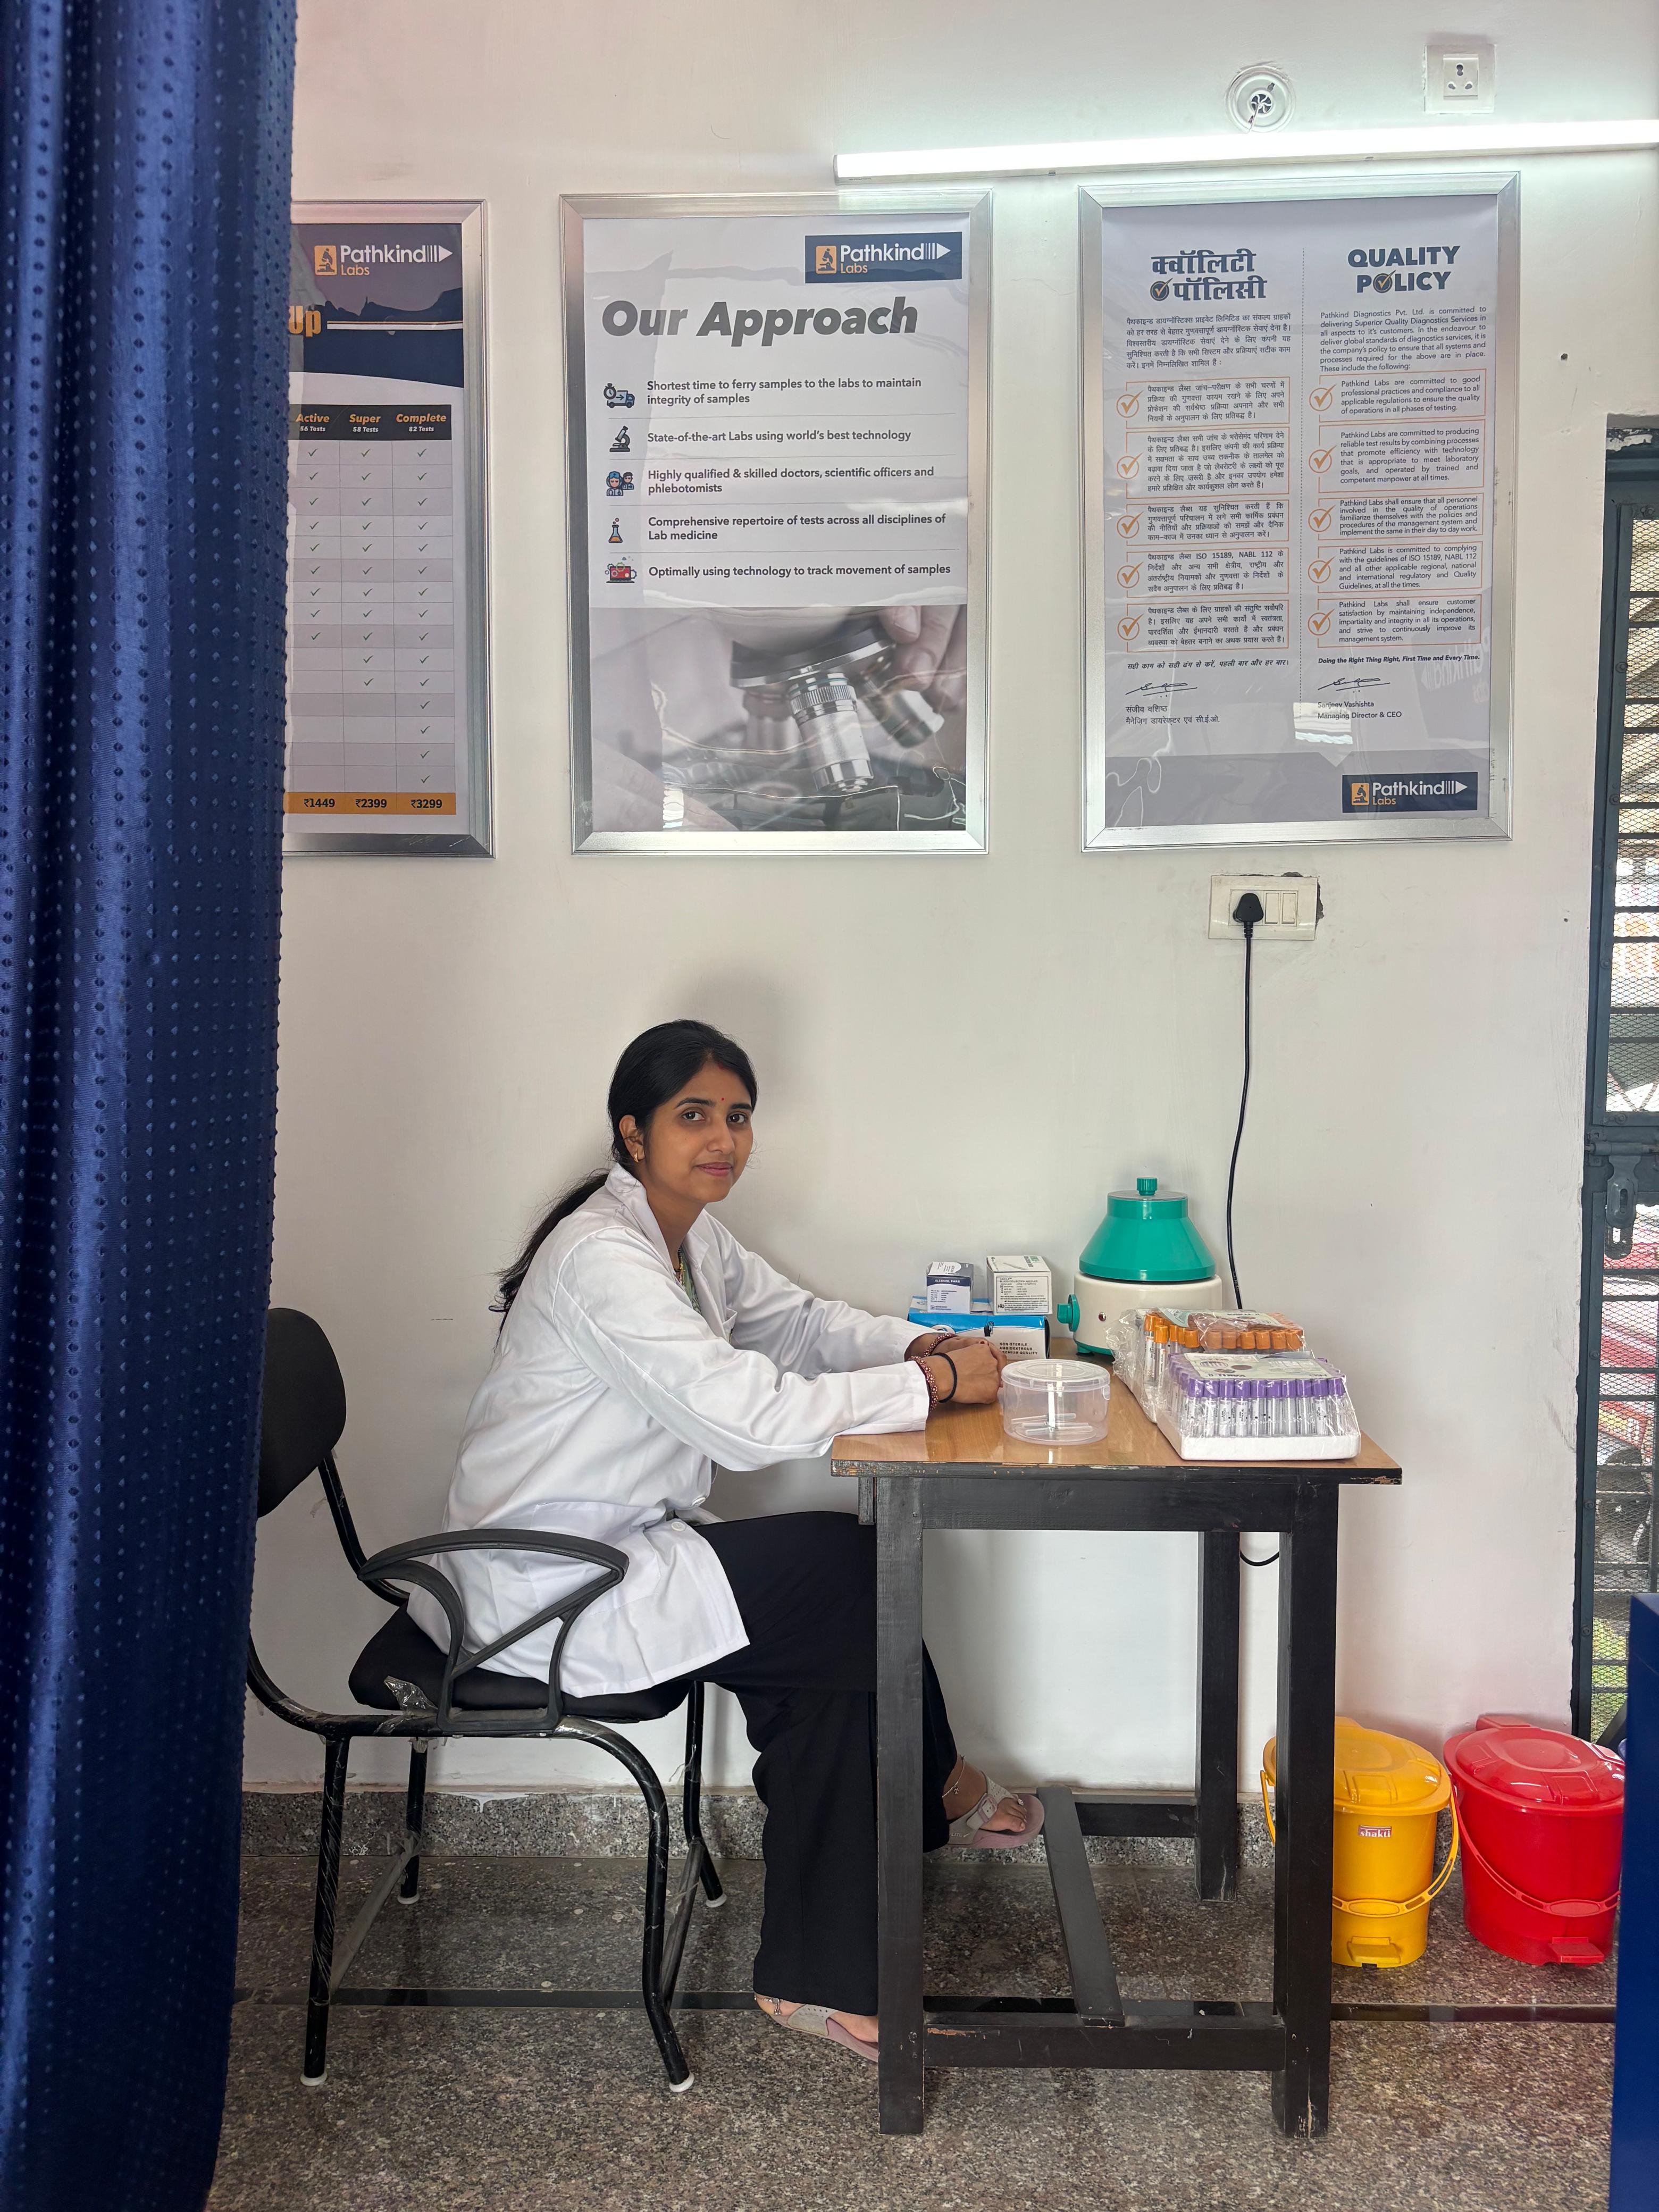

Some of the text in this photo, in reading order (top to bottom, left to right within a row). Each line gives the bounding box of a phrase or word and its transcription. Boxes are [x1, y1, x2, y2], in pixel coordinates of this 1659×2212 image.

[340, 244, 426, 263] Pathkind
[840, 242, 924, 262] Pathkind
[1347, 245, 1461, 268] QUALITY
[1151, 248, 1257, 275] क्वॉलिटी
[340, 264, 370, 275] Labs
[840, 263, 868, 273] Labs
[1172, 275, 1268, 301] पॉलिसी
[1353, 310, 1392, 319] Diagnostics
[1438, 306, 1475, 314] committed
[602, 296, 918, 347] Our Approach
[1355, 319, 1383, 328] Superior
[1385, 318, 1409, 326] Quality
[1410, 316, 1449, 326] Diagnostics
[1344, 337, 1364, 346] global
[1407, 334, 1444, 343] diagnostics
[1333, 346, 1367, 355] company's
[1368, 345, 1388, 354] policy
[1356, 354, 1384, 363] required
[1465, 350, 1485, 359] place.
[647, 377, 921, 391] Shortest time to ferry samples to the labs to maintain
[647, 392, 750, 407] integrity of samples
[296, 413, 330, 423] Active
[349, 414, 381, 425] Super
[396, 413, 447, 425] Complete
[647, 429, 911, 443] State-of-the-art Labs using world's best technology
[648, 466, 934, 482] Highly qualified & skilled doctors, scientific officers and
[648, 483, 722, 496] phlebotomists
[648, 516, 730, 529] Comprehensive
[732, 516, 784, 528] repertoire
[786, 515, 798, 525] of
[800, 516, 824, 525] tests
[862, 514, 874, 524] all
[877, 514, 932, 526] disciplines
[935, 513, 946, 523] of
[649, 530, 718, 540] Lab medicine
[649, 563, 951, 579] Optimally using technology to track movement of samples
[1125, 703, 1168, 713] संजीव वशिष्ठ
[1183, 715, 1193, 724] एवं
[1318, 711, 1350, 720] Managing
[1372, 781, 1445, 796] Pathkind
[304, 798, 336, 808] ₹1449
[355, 798, 387, 808] ₹2399
[410, 799, 442, 809] ₹3299
[1372, 797, 1396, 805] Labs
[1360, 1829, 1390, 1838] shakti
